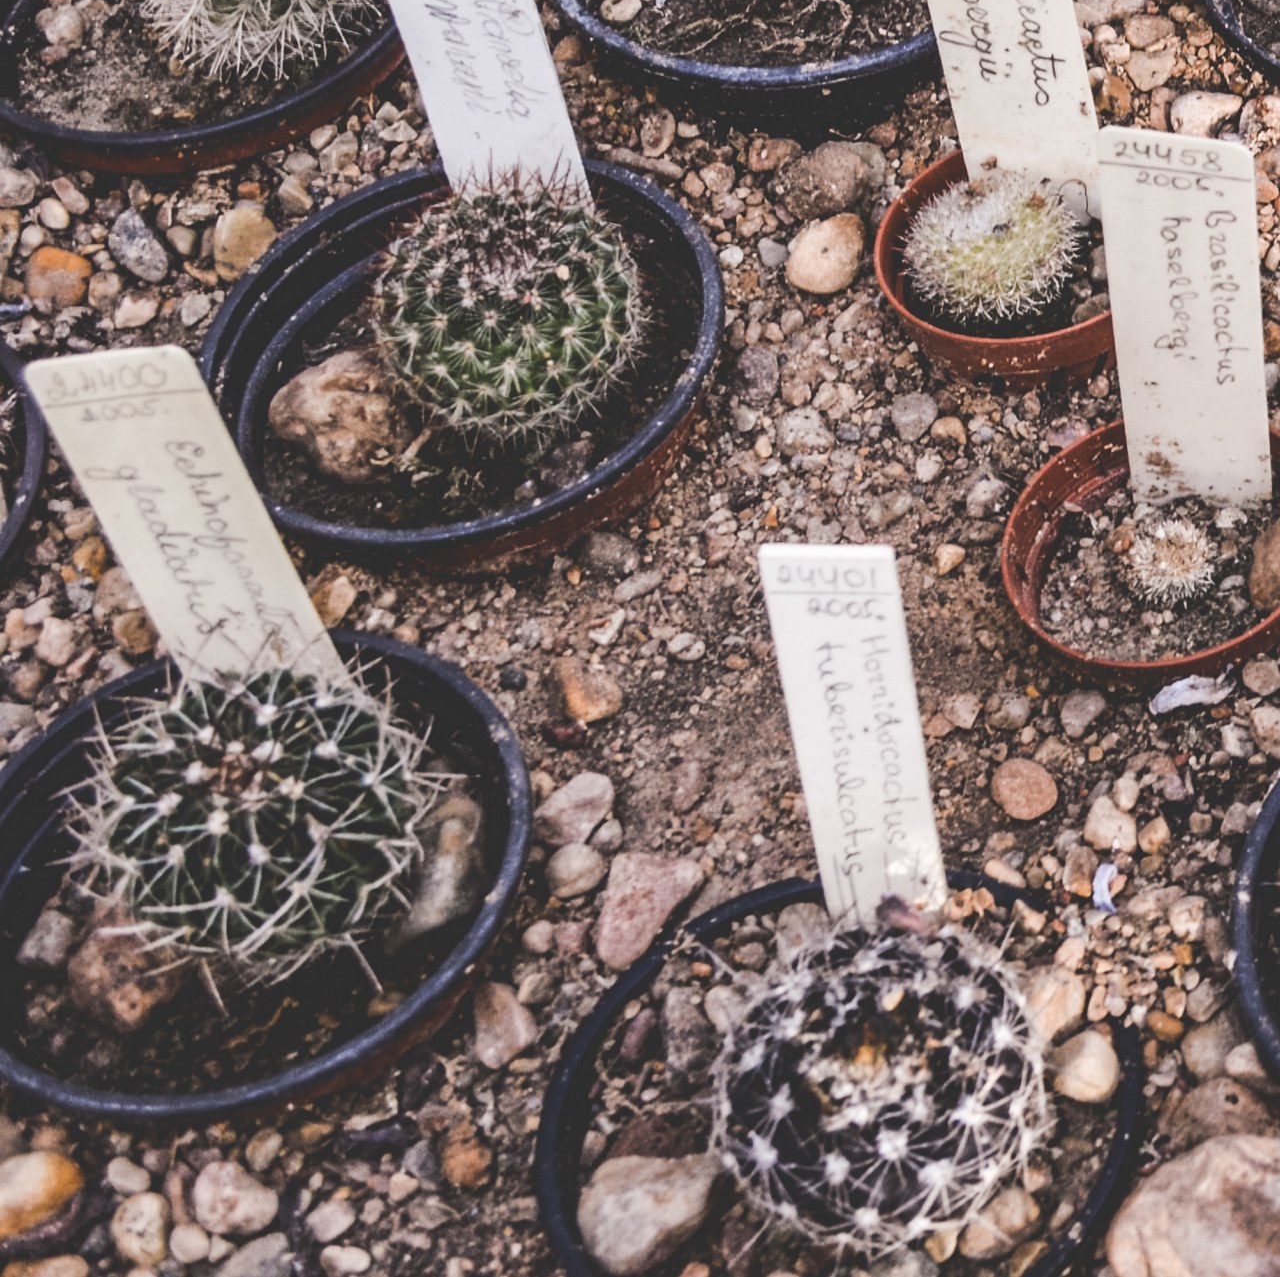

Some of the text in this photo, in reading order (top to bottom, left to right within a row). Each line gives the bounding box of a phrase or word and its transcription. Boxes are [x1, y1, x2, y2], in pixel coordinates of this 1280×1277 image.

[1113, 139, 1223, 174] 24458
[1204, 209, 1250, 386] Brasilicactus
[52, 362, 166, 401] 24400
[776, 564, 877, 593] 24401
[860, 632, 919, 847] Horridocactus
